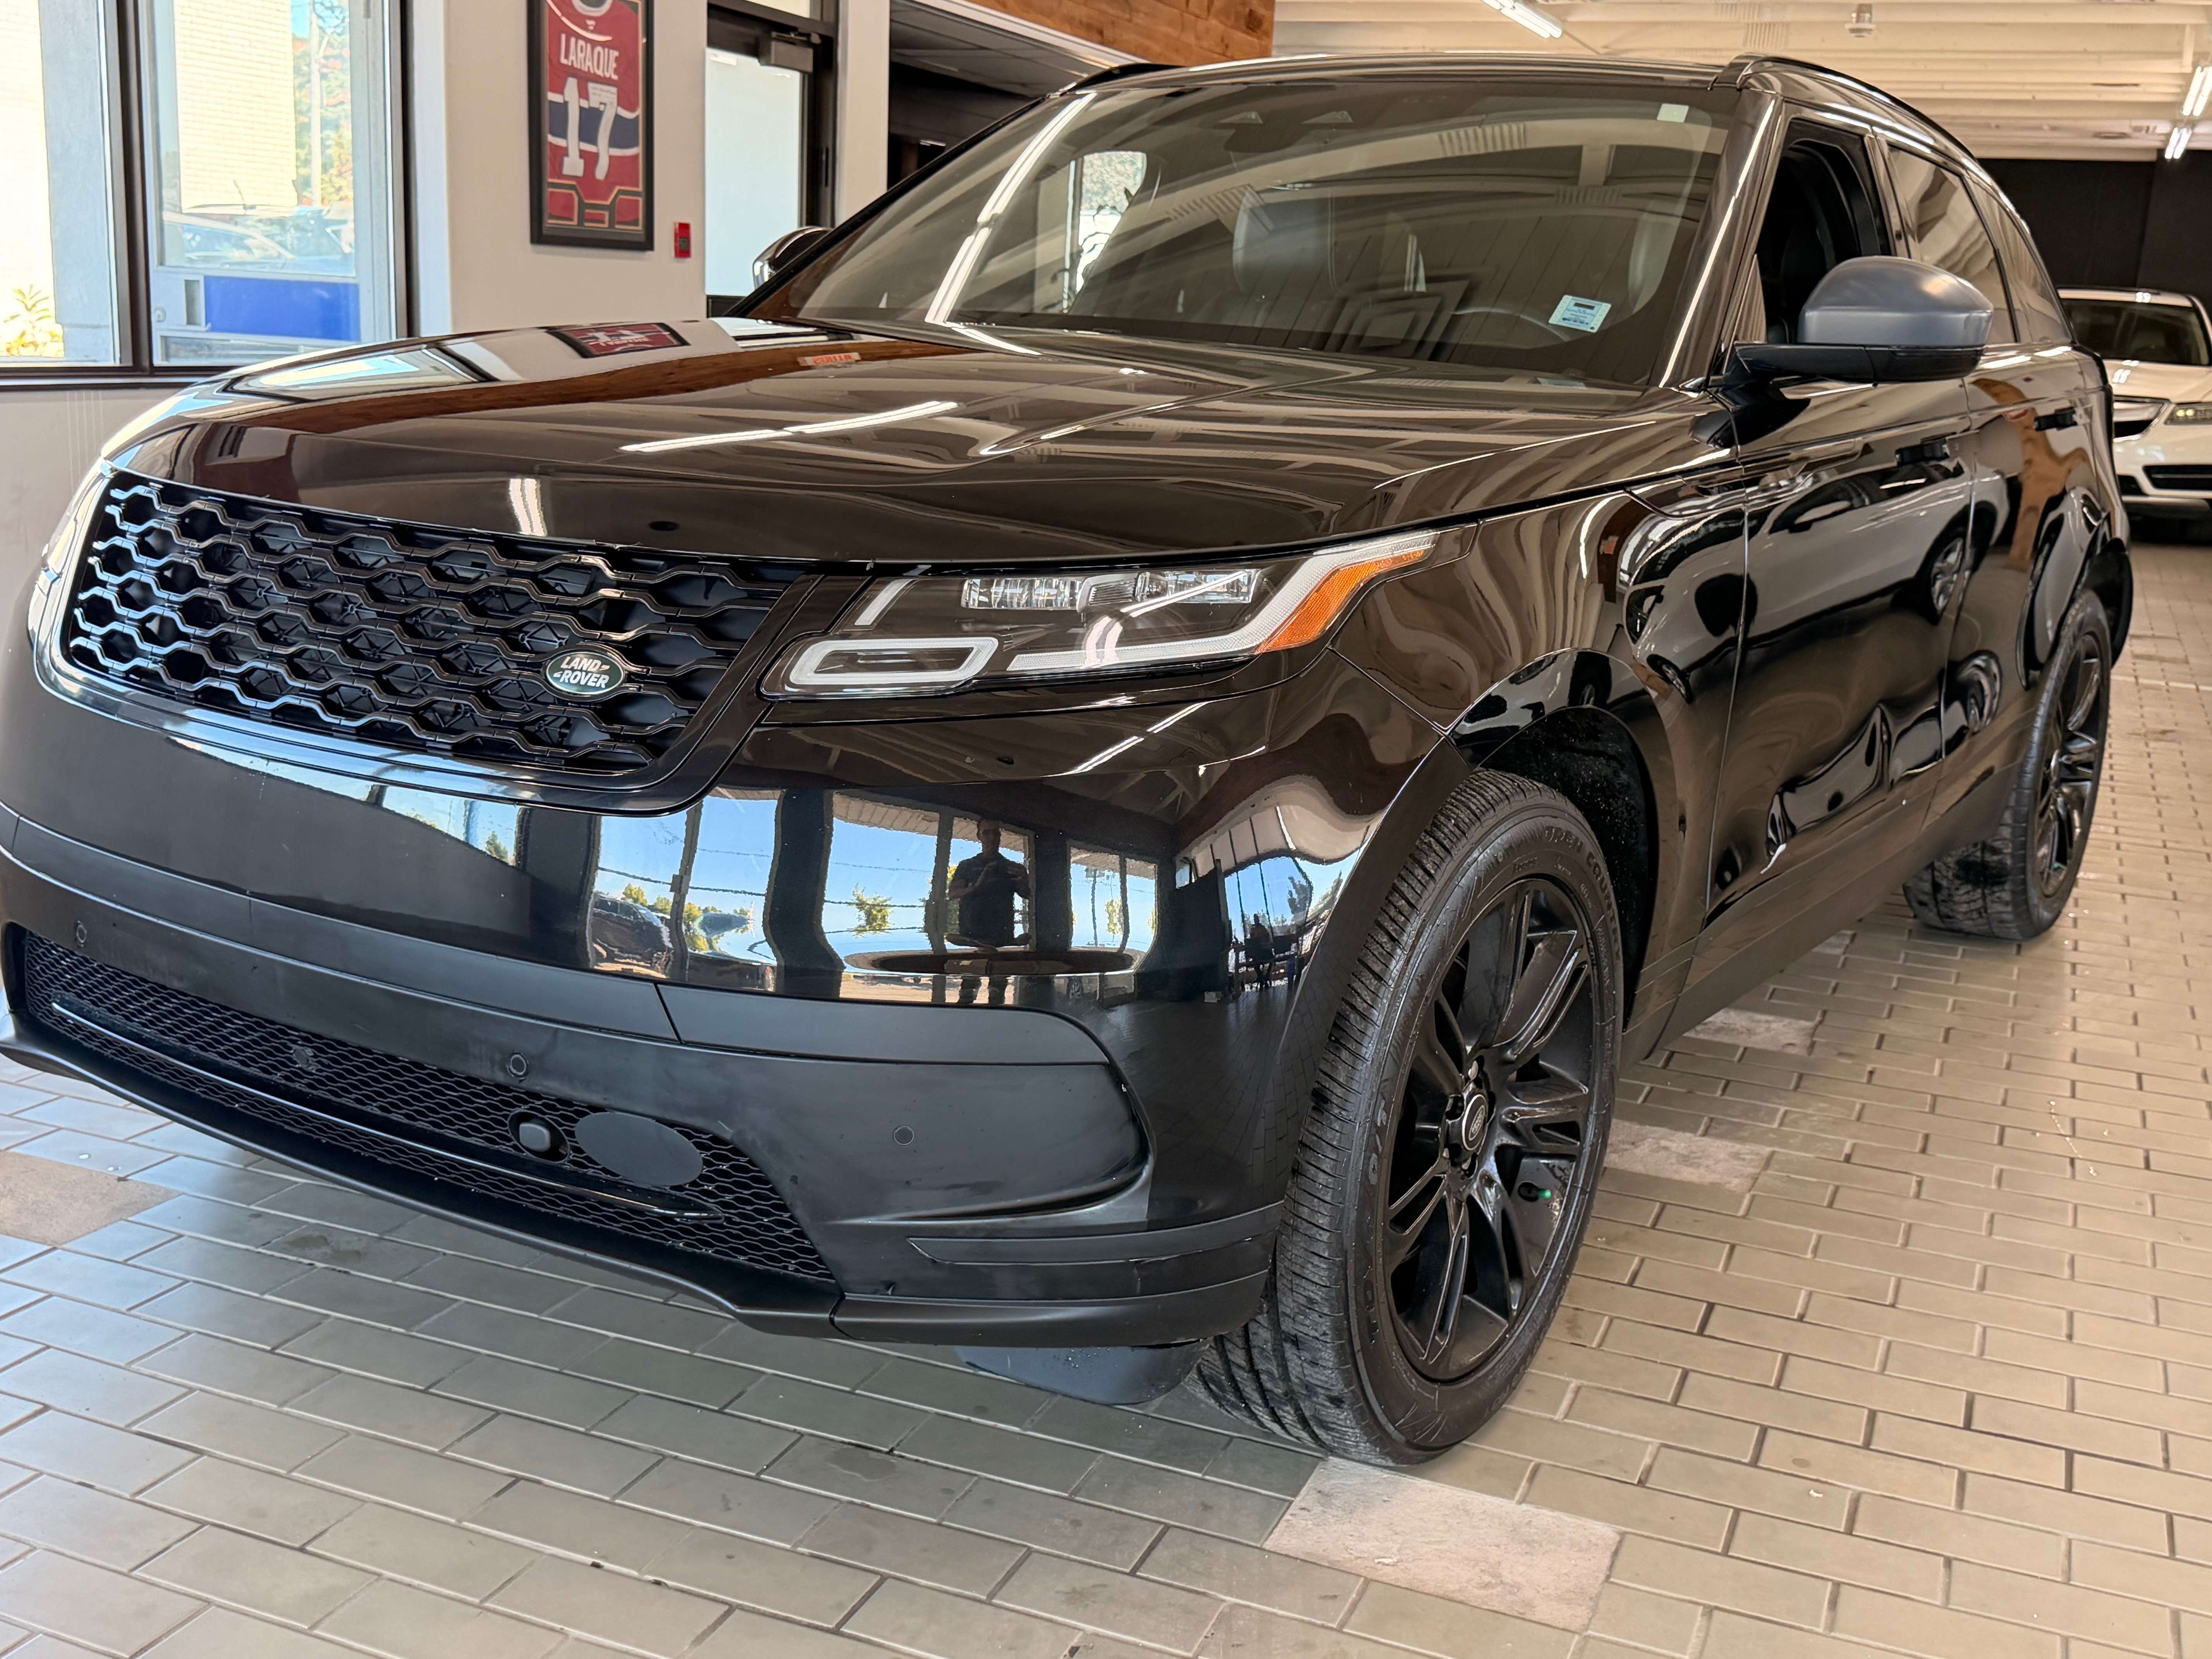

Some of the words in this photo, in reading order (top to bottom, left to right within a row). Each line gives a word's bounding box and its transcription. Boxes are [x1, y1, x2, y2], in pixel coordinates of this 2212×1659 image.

[560, 34, 619, 80] LARAQUE
[562, 77, 618, 180] 17
[560, 670, 609, 688] ROVER
[561, 657, 602, 672] LAND
[1586, 851, 1621, 961] COUNTRY
